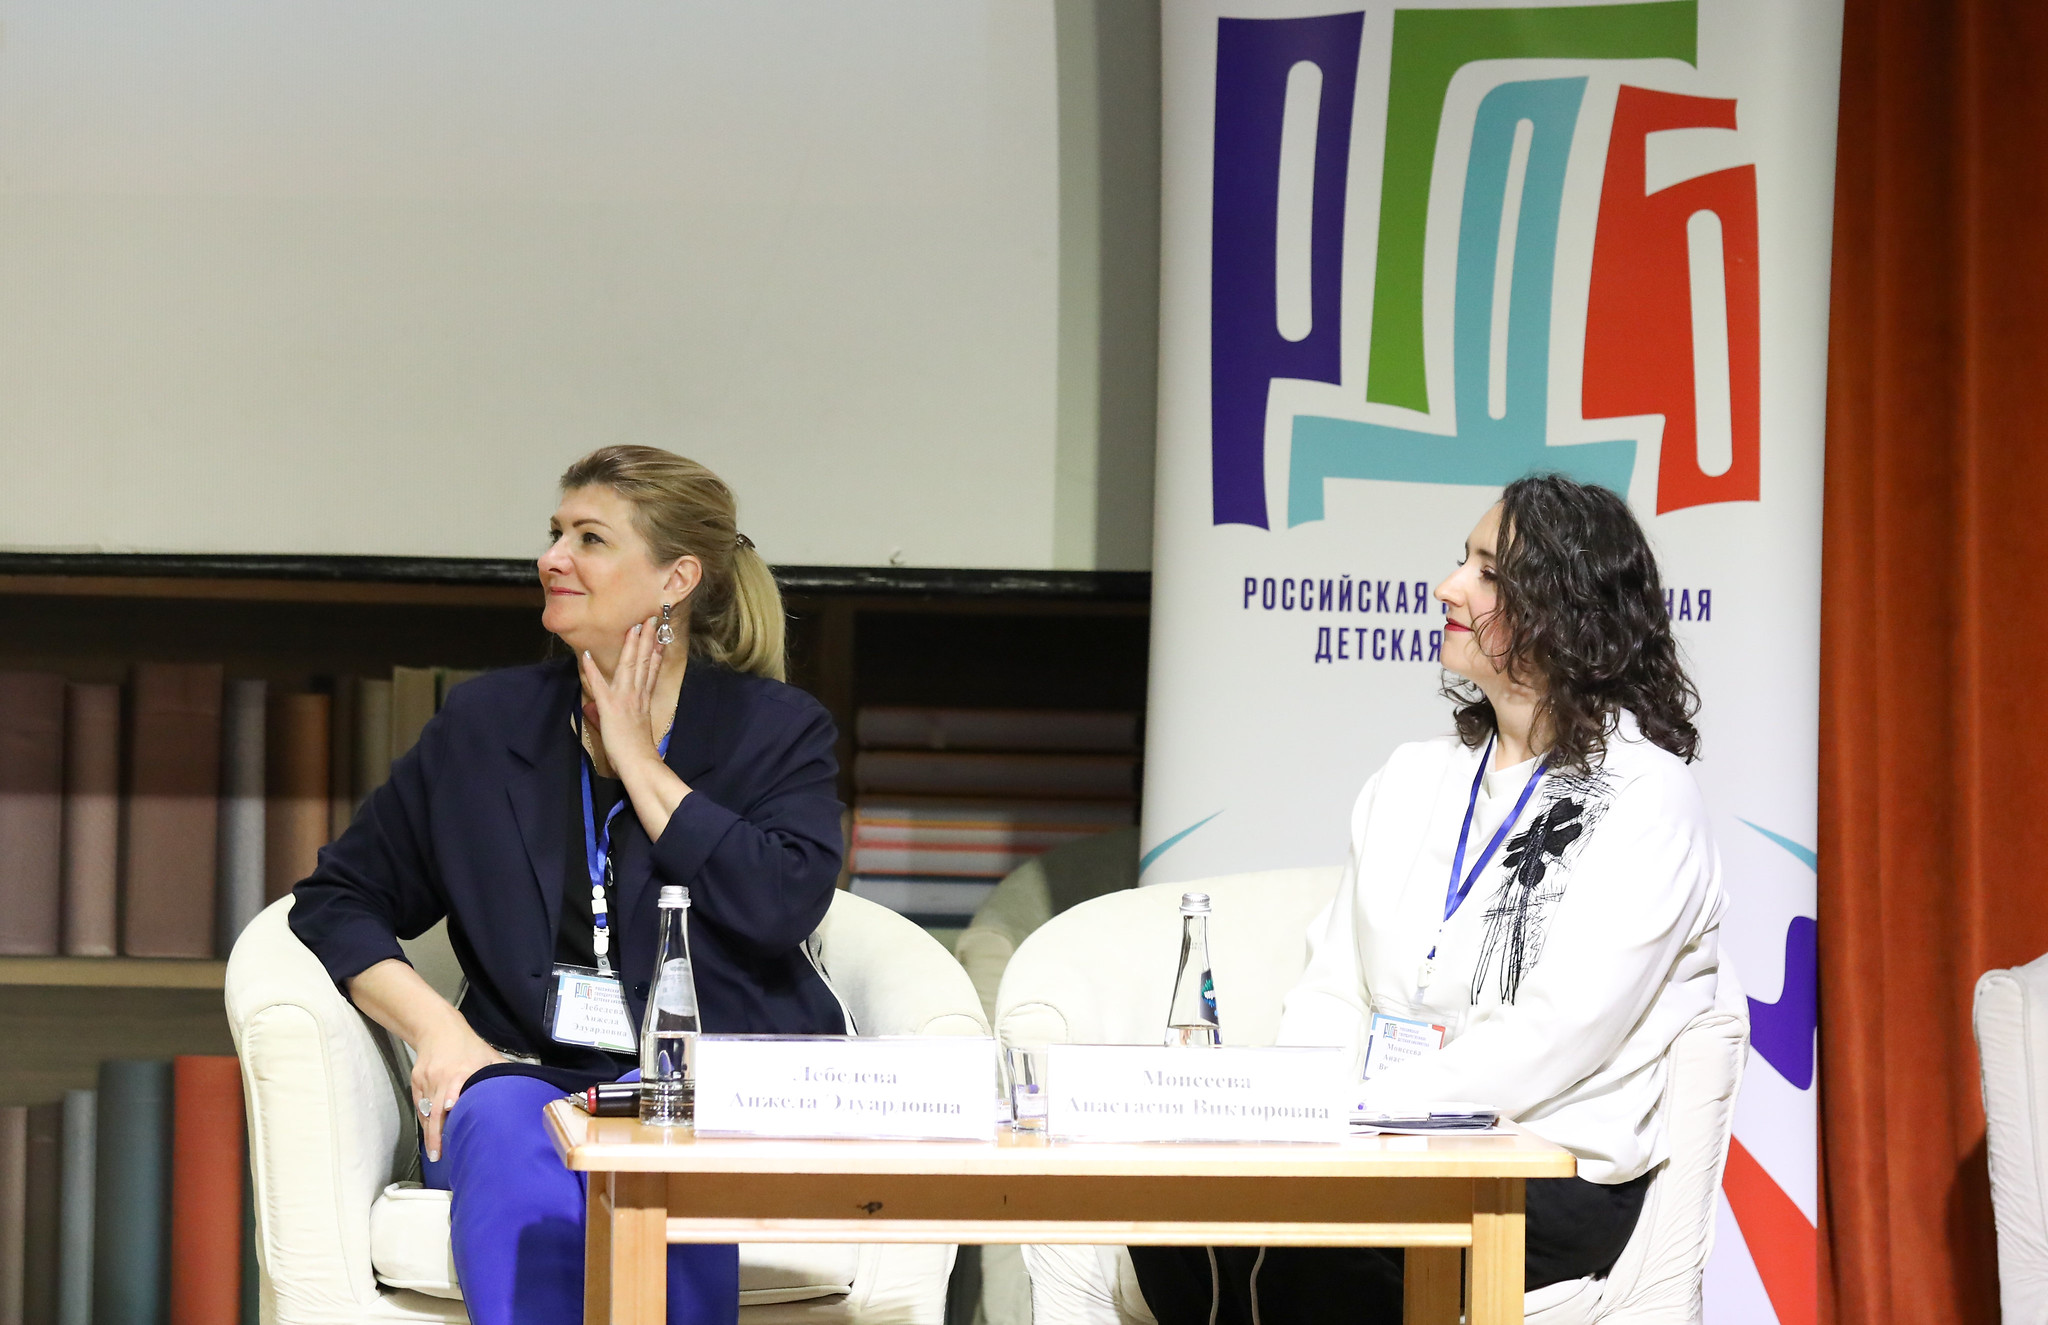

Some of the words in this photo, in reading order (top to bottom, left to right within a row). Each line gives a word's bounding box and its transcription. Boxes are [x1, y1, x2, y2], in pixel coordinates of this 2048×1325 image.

[1243, 574, 1429, 615] РОССИЙСКАЯ
[1314, 626, 1442, 664] ДЕТСКАЯ
[793, 1066, 898, 1085] Лебедева
[1143, 1070, 1251, 1089] Моисеева
[730, 1092, 817, 1110] Анжела
[826, 1094, 961, 1117] Эдуардовна
[1066, 1096, 1184, 1115] Анастасия
[1193, 1098, 1329, 1122] Викторовна
